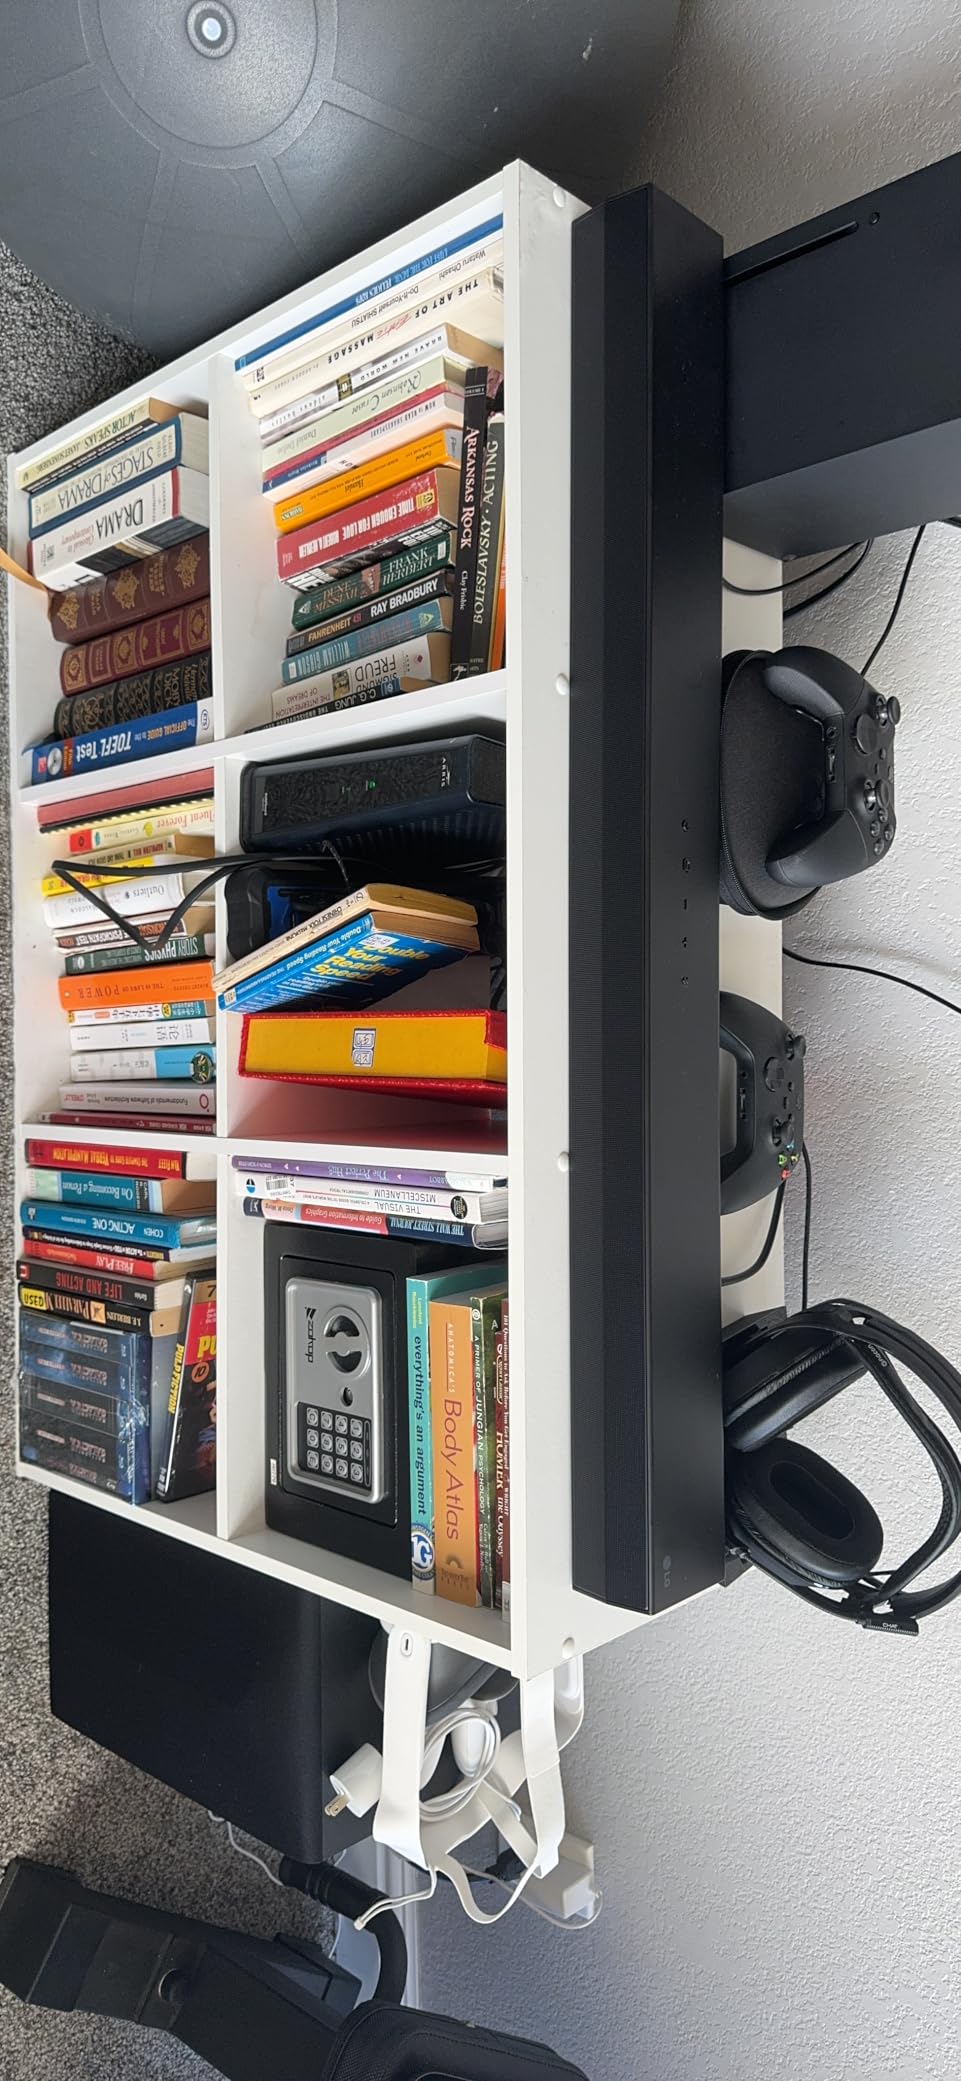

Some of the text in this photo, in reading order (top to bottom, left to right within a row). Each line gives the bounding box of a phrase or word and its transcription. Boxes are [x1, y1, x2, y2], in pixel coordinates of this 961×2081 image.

[439, 249, 486, 280] Wataru Ohashi
[379, 286, 419, 312] Do-It-Yourself
[328, 279, 478, 364] THE ART OF MASSAGE
[352, 309, 377, 328] SHIATSU
[361, 336, 442, 381] BRAVE NEW WORLD
[352, 370, 421, 415] Robinson Crusoe
[112, 410, 136, 433] ACTOR
[371, 400, 436, 438] HOW READ SHAKESPEARE
[84, 425, 110, 449] SPEAKS
[297, 429, 316, 449] Daniel
[57, 447, 154, 510] STAGES DRAMA
[345, 480, 364, 493] Hamlet
[460, 426, 480, 550] ARKANSAS ROCK
[95, 499, 143, 540] DRAMA
[342, 498, 415, 541] TIME ENOUGH FOR LOVE
[473, 440, 498, 624] BOLESLAVSKY ACTING
[383, 557, 433, 585] HERBERT
[389, 547, 428, 572] FRANK
[315, 586, 357, 612] MESSIAH
[323, 582, 351, 599] DUNE
[370, 578, 439, 617] RAY BRADBURY
[308, 618, 352, 642] FAHRENHEIT
[297, 641, 350, 676] WILLIAM GIBSON
[355, 654, 397, 682] FREUD
[356, 673, 397, 692] SIGMUND
[275, 694, 331, 718] THE INTERPRETATION
[286, 687, 318, 704] OF DREAMS
[334, 694, 356, 710] JUNG
[318, 705, 329, 715] THE
[76, 719, 196, 762] The OFFICIAL GUIDE TOEFL Test
[440, 757, 448, 788] ARRIS
[156, 815, 187, 831] Forever
[133, 885, 164, 898] Outliers
[321, 906, 342, 921] CHINESE
[76, 934, 89, 946] TEST
[285, 926, 308, 941] MEDICINE
[177, 937, 198, 957] STORY
[286, 926, 361, 970] Double Your Reading Speed
[344, 947, 382, 962] Your
[363, 944, 429, 960] Double
[78, 984, 120, 999] POWER
[104, 1096, 188, 1106] Fundamentals Software Architecture
[89, 1150, 110, 1167] VERBAL
[345, 1167, 388, 1180] The Perfect
[62, 1181, 133, 1199] On Becoming Person
[374, 1188, 437, 1204] MISCELLANEUM
[305, 1207, 383, 1225] Guide to Information Graphics
[374, 1201, 422, 1215] THE VISUAL
[92, 1217, 107, 1231] ONE
[107, 1220, 135, 1234] ACTING
[143, 1227, 164, 1239] COHEN
[390, 1217, 465, 1236] THE WALL STREET JOURNAL
[95, 1256, 134, 1274] FREE PLAY
[56, 1272, 123, 1300] LIFE AND ACTING
[24, 1293, 44, 1308] USED
[55, 1294, 90, 1319] PARALLEL
[305, 1319, 316, 1363] zokop
[168, 1344, 185, 1413] PULP FICTION
[413, 1336, 425, 1420] everything's
[475, 1380, 481, 1393] OF
[416, 1425, 425, 1442] an
[440, 1322, 464, 1540] ANATOMICA'S Body Atlas
[476, 1395, 484, 1450] JUNGIAN
[415, 1447, 427, 1516] argument
[478, 1455, 486, 1515] PSYCHOLOGY
[496, 1431, 504, 1557] HOMER the Odyssey
[663, 1571, 671, 1588] LG
